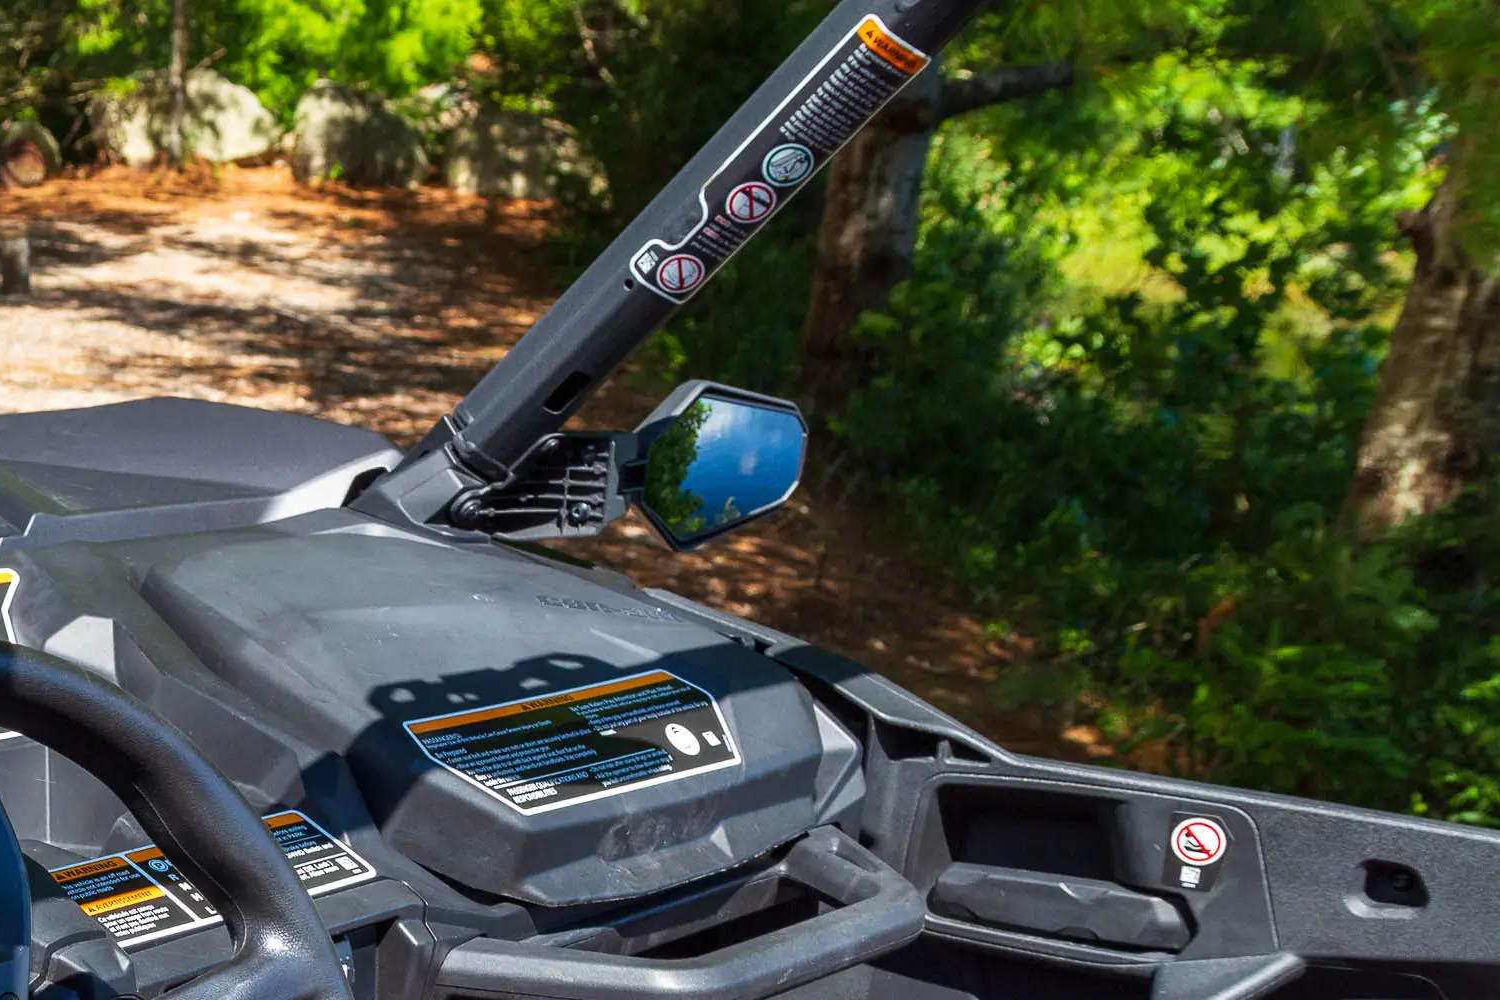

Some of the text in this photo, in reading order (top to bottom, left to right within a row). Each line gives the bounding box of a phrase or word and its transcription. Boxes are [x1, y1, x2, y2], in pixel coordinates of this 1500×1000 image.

[526, 693, 575, 712] WARNING
[62, 859, 117, 879] WARNING
[94, 890, 152, 912] AVERTISSEMENT
